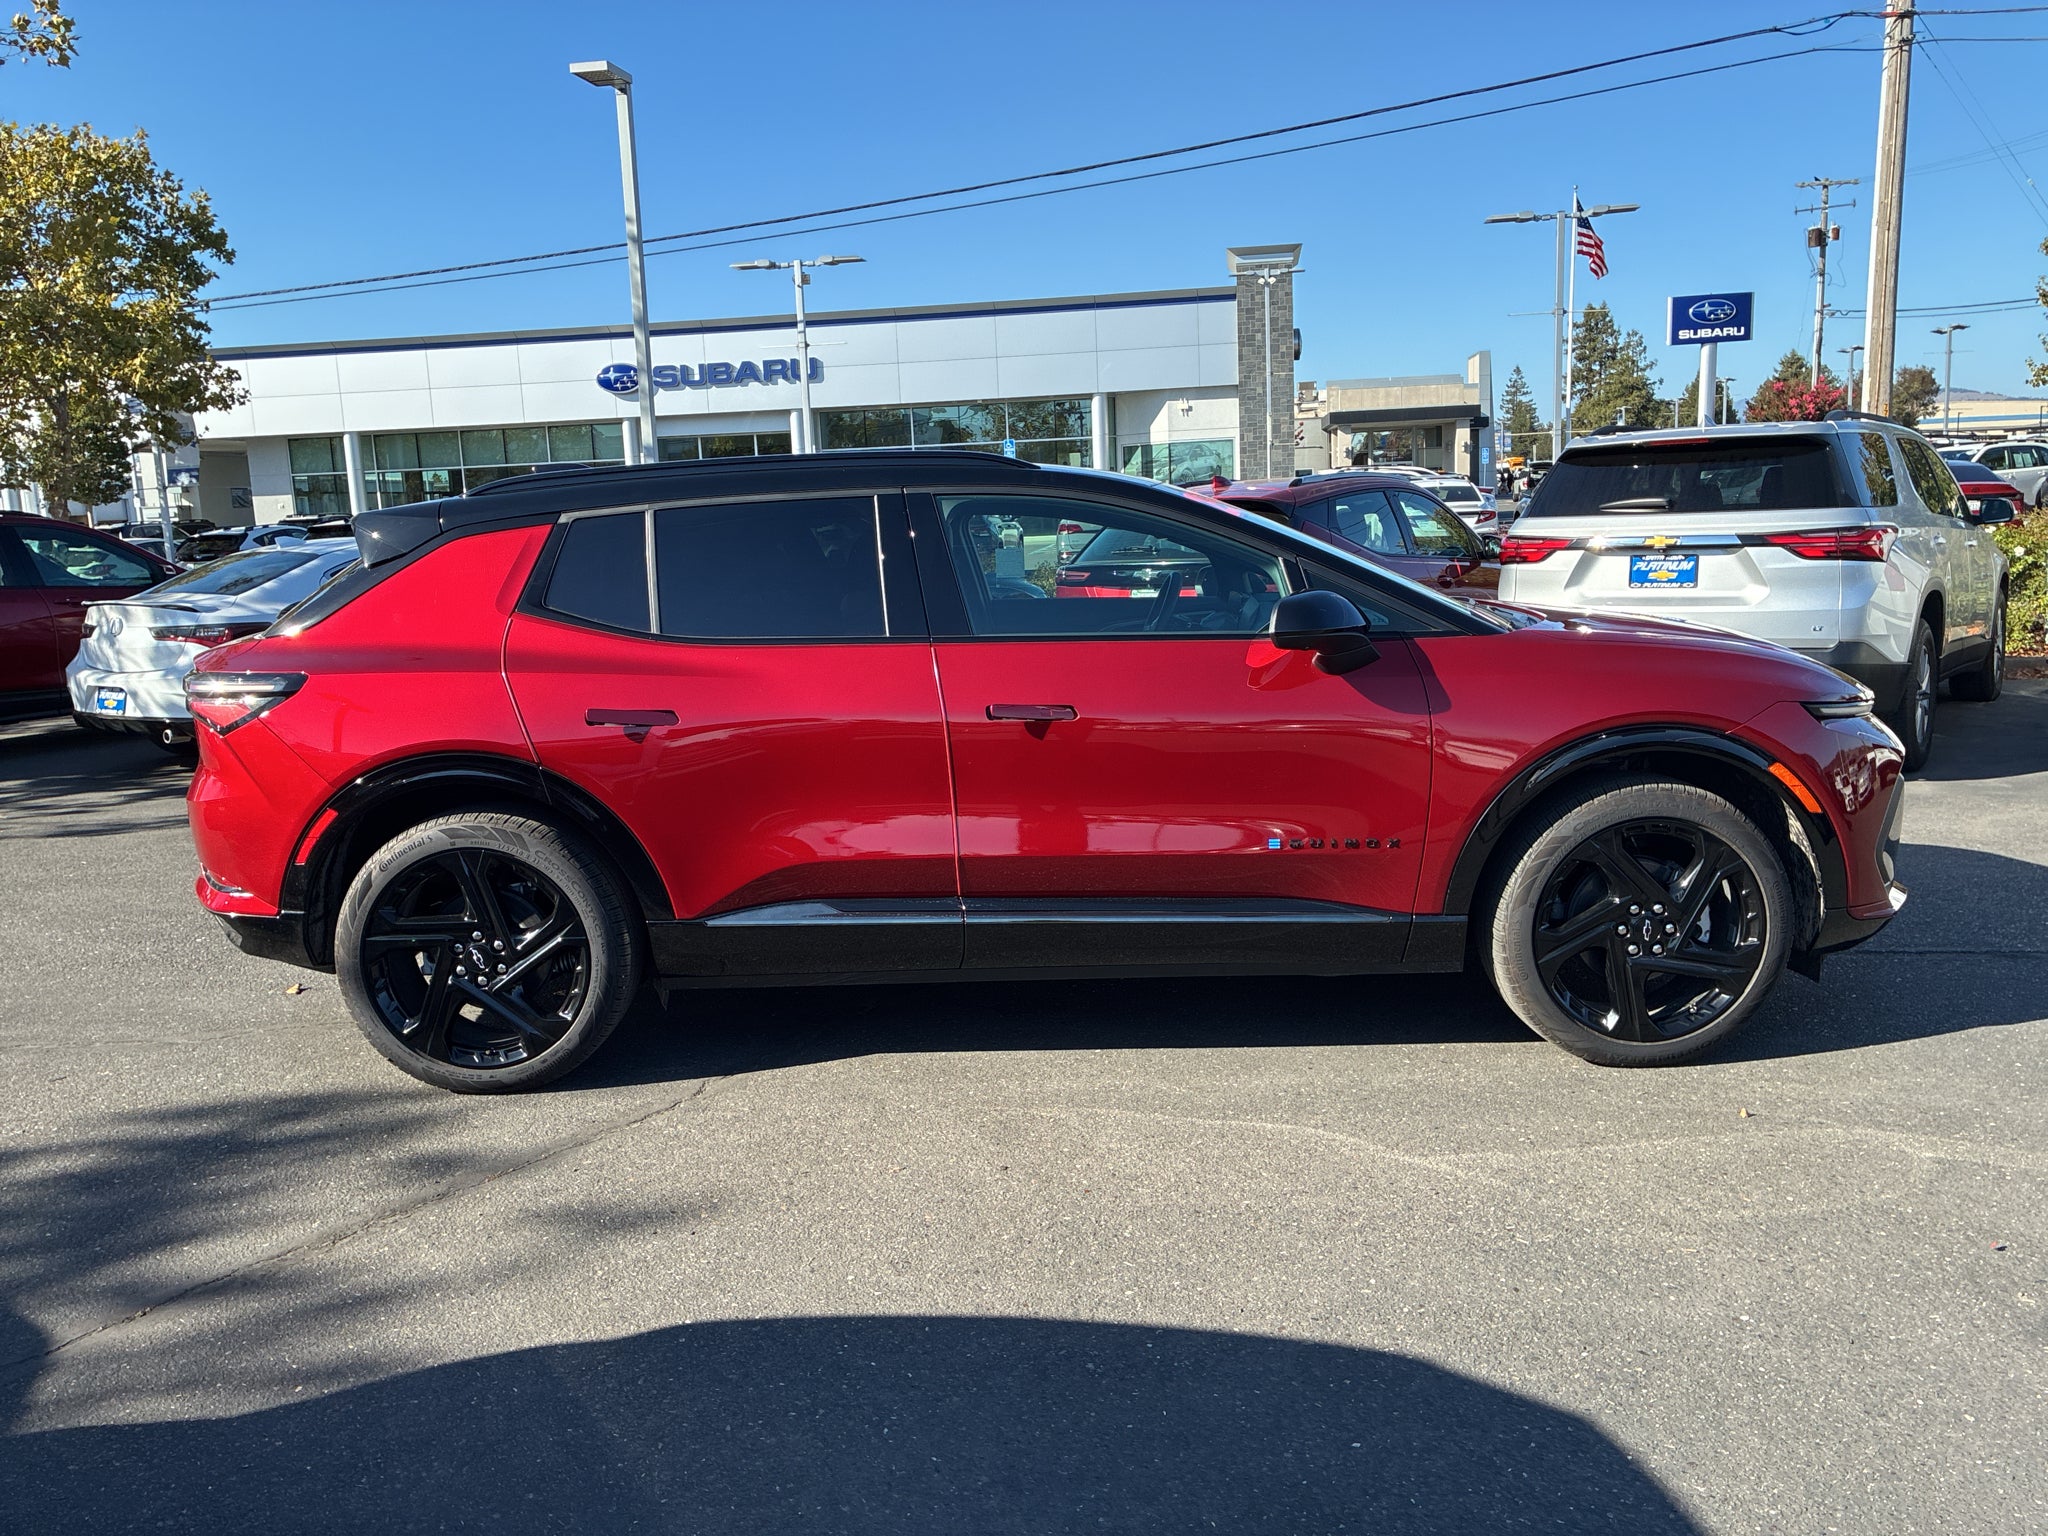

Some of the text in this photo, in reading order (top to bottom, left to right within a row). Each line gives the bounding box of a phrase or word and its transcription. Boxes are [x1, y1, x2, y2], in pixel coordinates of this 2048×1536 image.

[1678, 326, 1745, 339] SUBARU
[652, 357, 820, 387] SUBARU
[1632, 561, 1695, 571] PLATINUM
